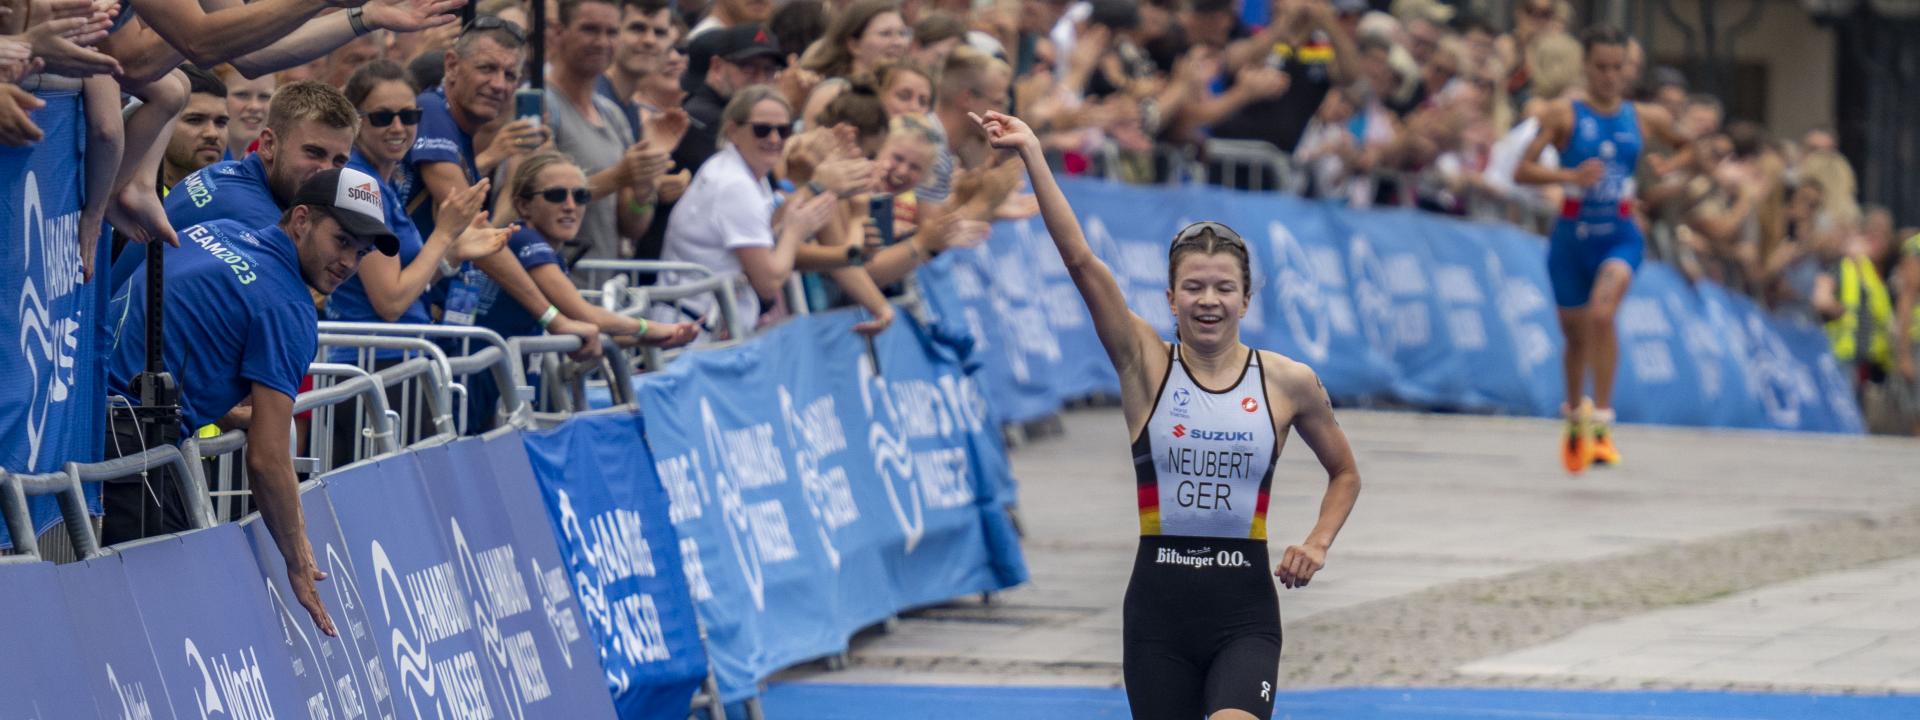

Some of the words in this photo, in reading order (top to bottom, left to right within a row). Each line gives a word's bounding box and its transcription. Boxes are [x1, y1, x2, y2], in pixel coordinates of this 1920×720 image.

[182, 224, 257, 285] TEAM2023
[1190, 429, 1254, 441] SUZUKI
[1168, 446, 1254, 480] NEUBERT
[1177, 480, 1232, 511] GER
[1156, 547, 1214, 568] Bitburger
[211, 645, 275, 720] World
